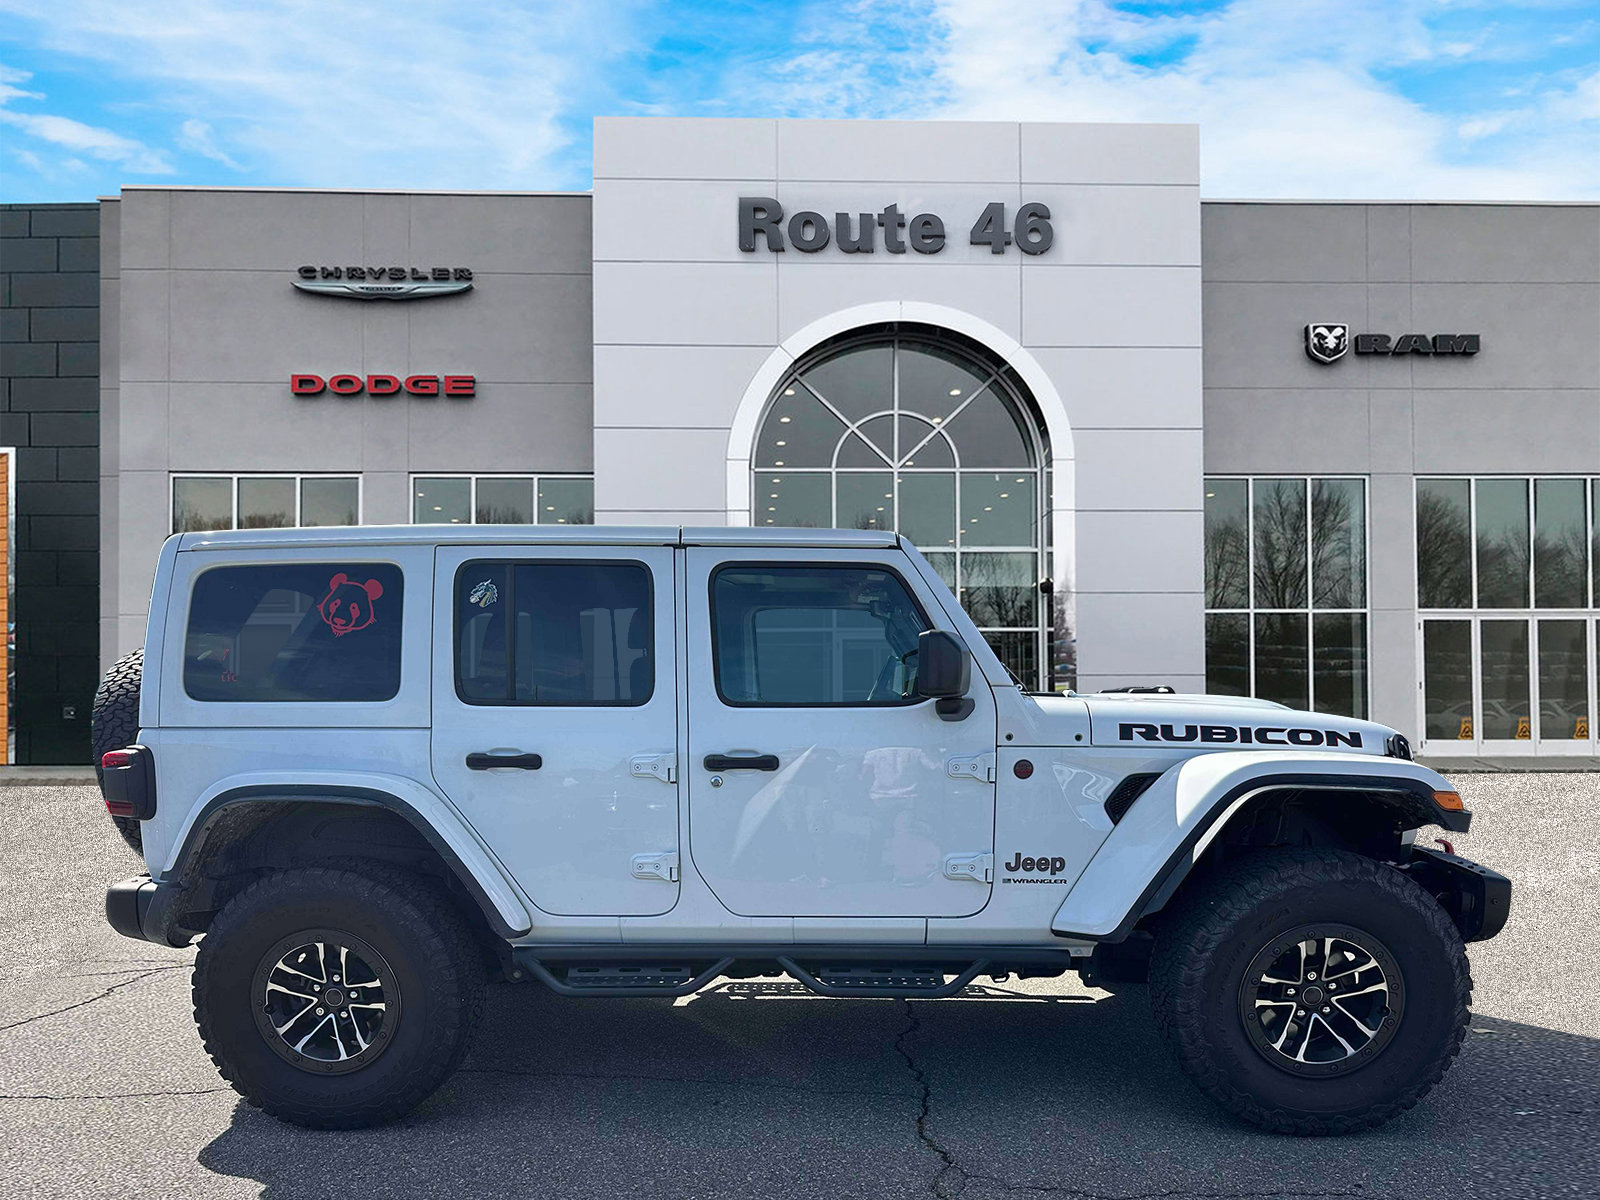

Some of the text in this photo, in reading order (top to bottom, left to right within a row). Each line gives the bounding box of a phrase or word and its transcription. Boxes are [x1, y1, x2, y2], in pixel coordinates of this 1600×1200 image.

[738, 197, 1054, 255] Route 46
[298, 266, 473, 280] CHRYSLER
[1354, 334, 1480, 354] RAM
[291, 374, 475, 396] DODGE
[1119, 723, 1363, 748] RUBICON
[1005, 852, 1066, 875] Jeep
